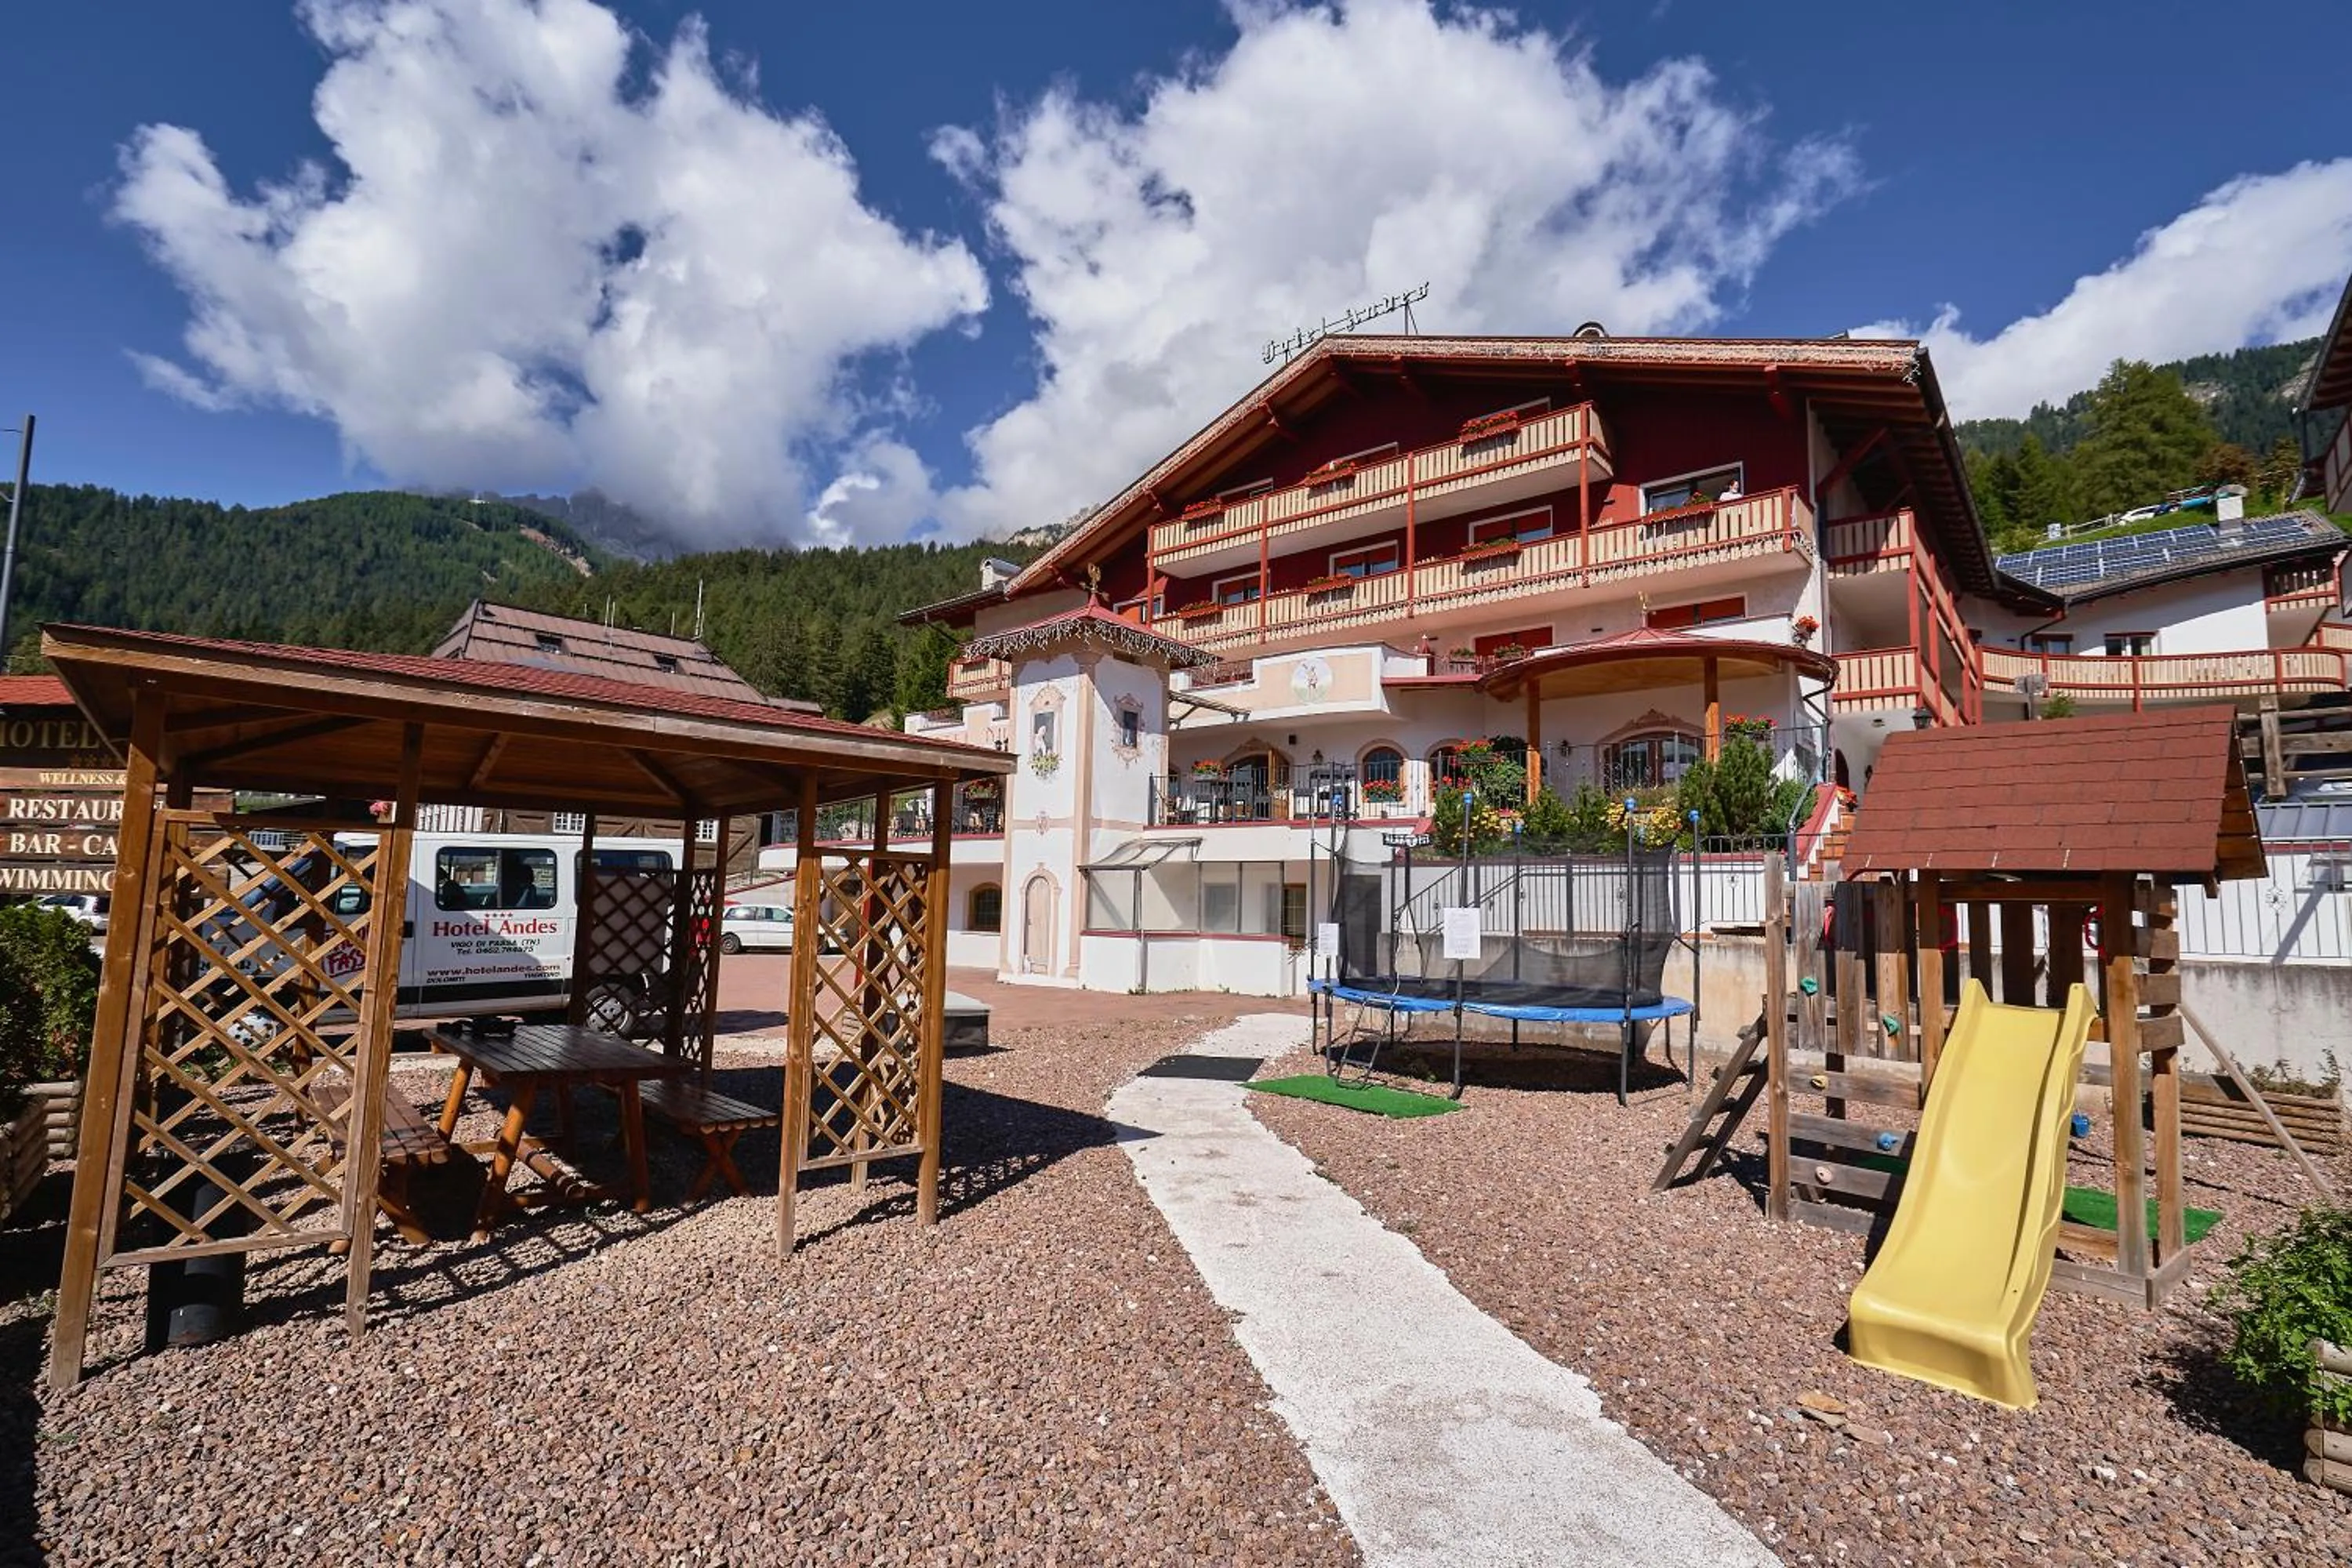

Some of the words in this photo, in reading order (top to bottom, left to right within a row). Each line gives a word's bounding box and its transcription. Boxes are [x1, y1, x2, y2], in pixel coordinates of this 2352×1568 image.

[39, 772, 114, 785] WELLNESS
[8, 798, 125, 821] RESTAUR
[9, 832, 62, 855] BAR
[82, 833, 119, 855] CA
[0, 867, 116, 891] WIMMING
[433, 918, 490, 937] Hotel
[498, 917, 557, 935] Andes
[325, 948, 366, 975] FASS
[426, 964, 561, 977] www.hotelandes.com
